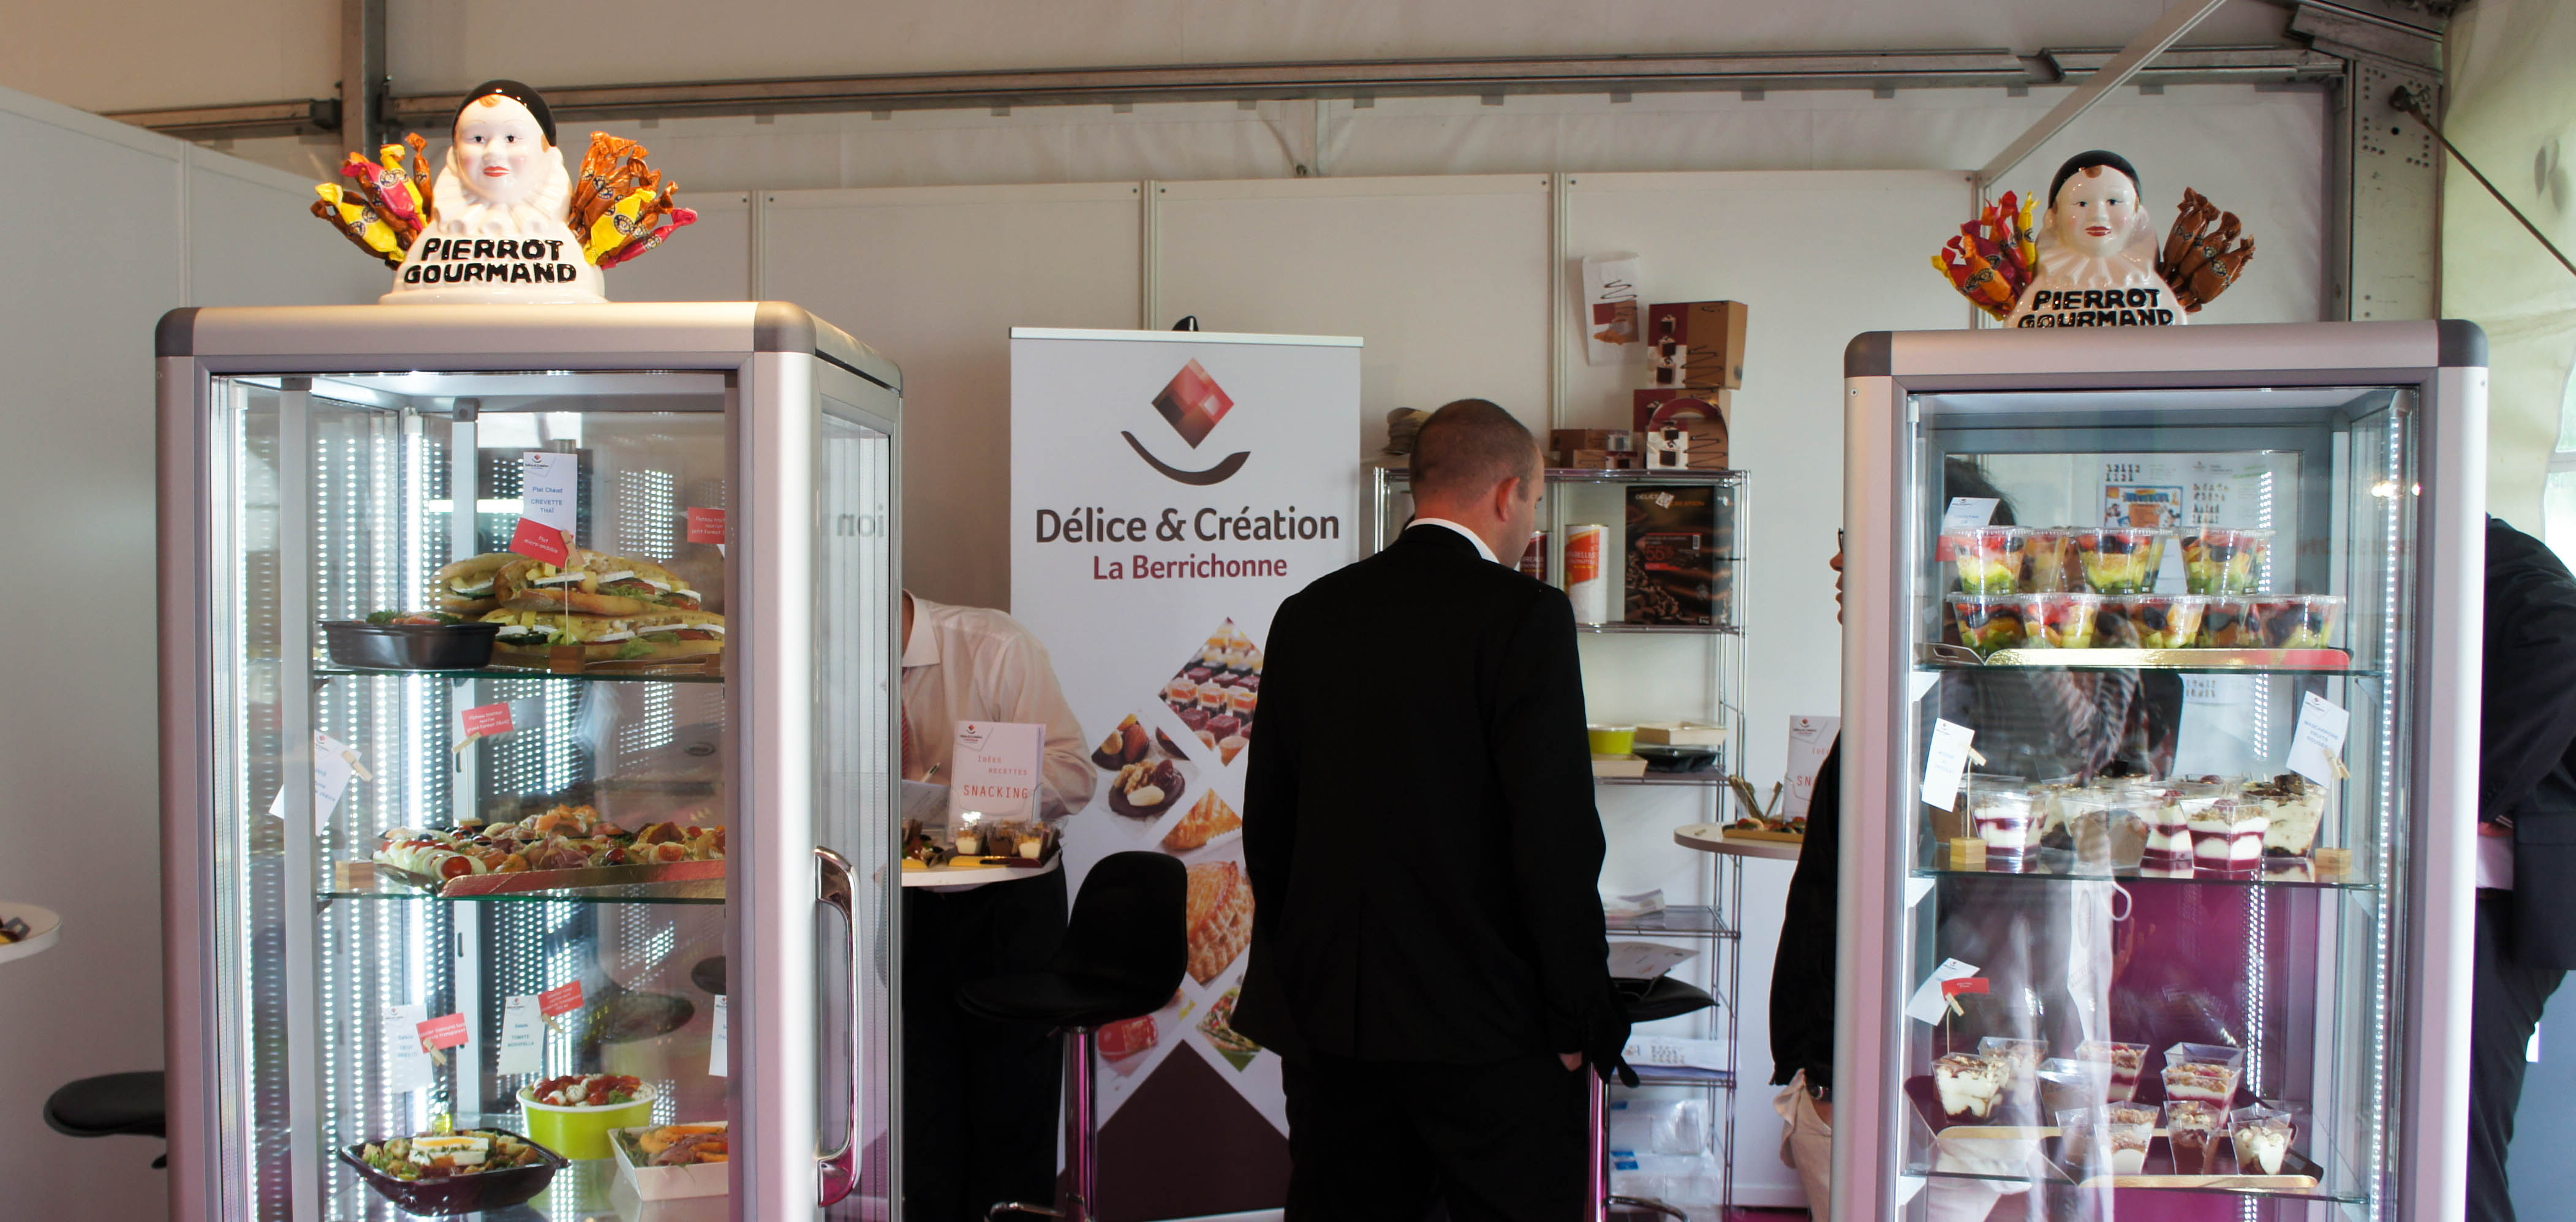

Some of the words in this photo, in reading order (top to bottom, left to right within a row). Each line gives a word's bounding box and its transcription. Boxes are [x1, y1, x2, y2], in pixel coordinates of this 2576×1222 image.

[421, 238, 564, 261] PIERROT
[404, 262, 576, 284] GOURMAND
[2032, 288, 2160, 311] PIERROT
[2017, 309, 2175, 328] GOURMAND
[1036, 507, 1146, 543] Délice
[1155, 508, 1187, 541] &
[1194, 506, 1339, 541] Création
[1093, 556, 1124, 579] La
[1133, 553, 1288, 579] Berrichonne
[964, 785, 1029, 799] SNACKING
